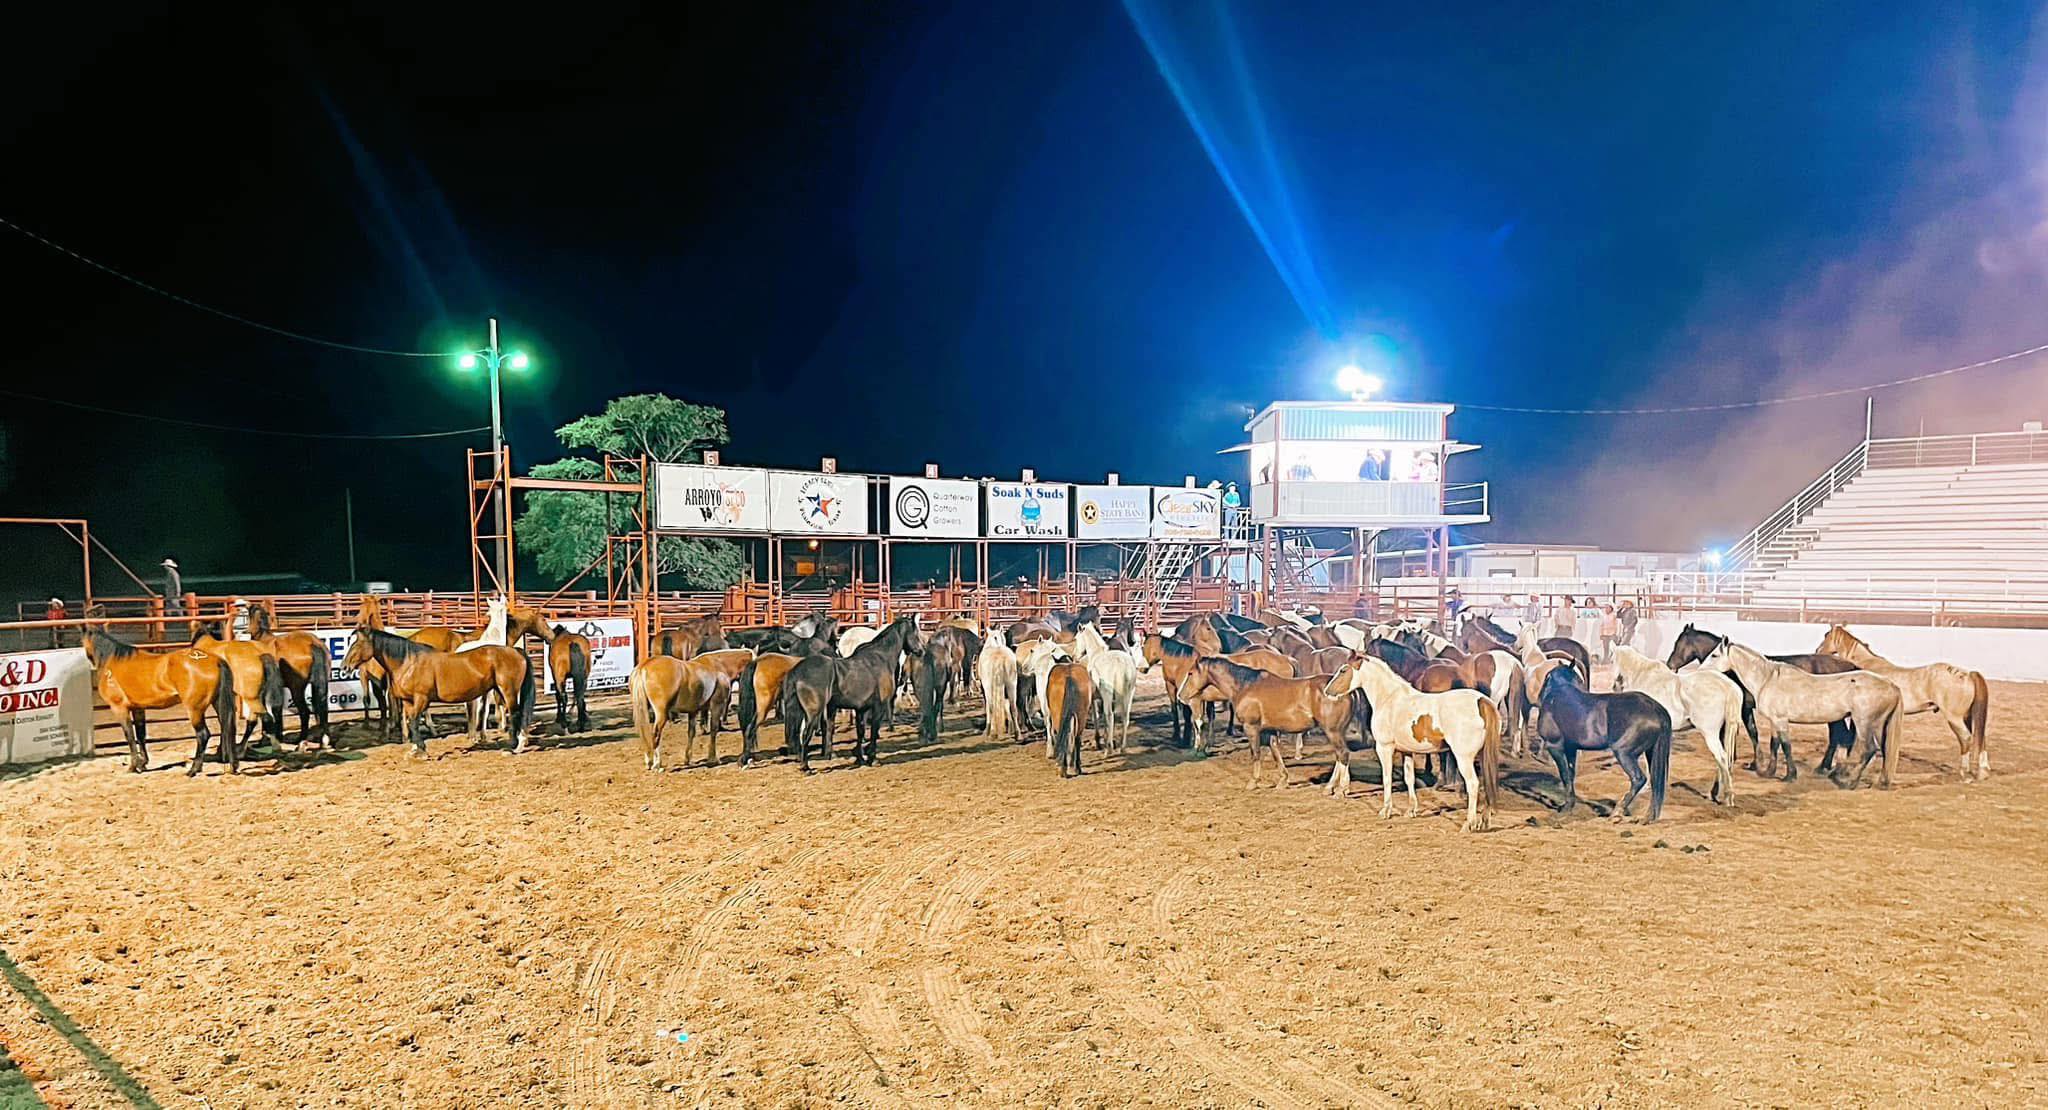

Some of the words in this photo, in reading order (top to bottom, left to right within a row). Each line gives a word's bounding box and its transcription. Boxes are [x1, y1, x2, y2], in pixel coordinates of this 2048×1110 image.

[685, 488, 722, 506] ARROYO
[992, 487, 1021, 497] Soak
[1025, 488, 1032, 498] N
[1036, 488, 1064, 499] Suds
[933, 504, 957, 513] Cotton
[994, 525, 1020, 535] Car
[1025, 524, 1063, 536] Wash
[0, 659, 47, 688] &D
[17, 690, 58, 710] INC.
